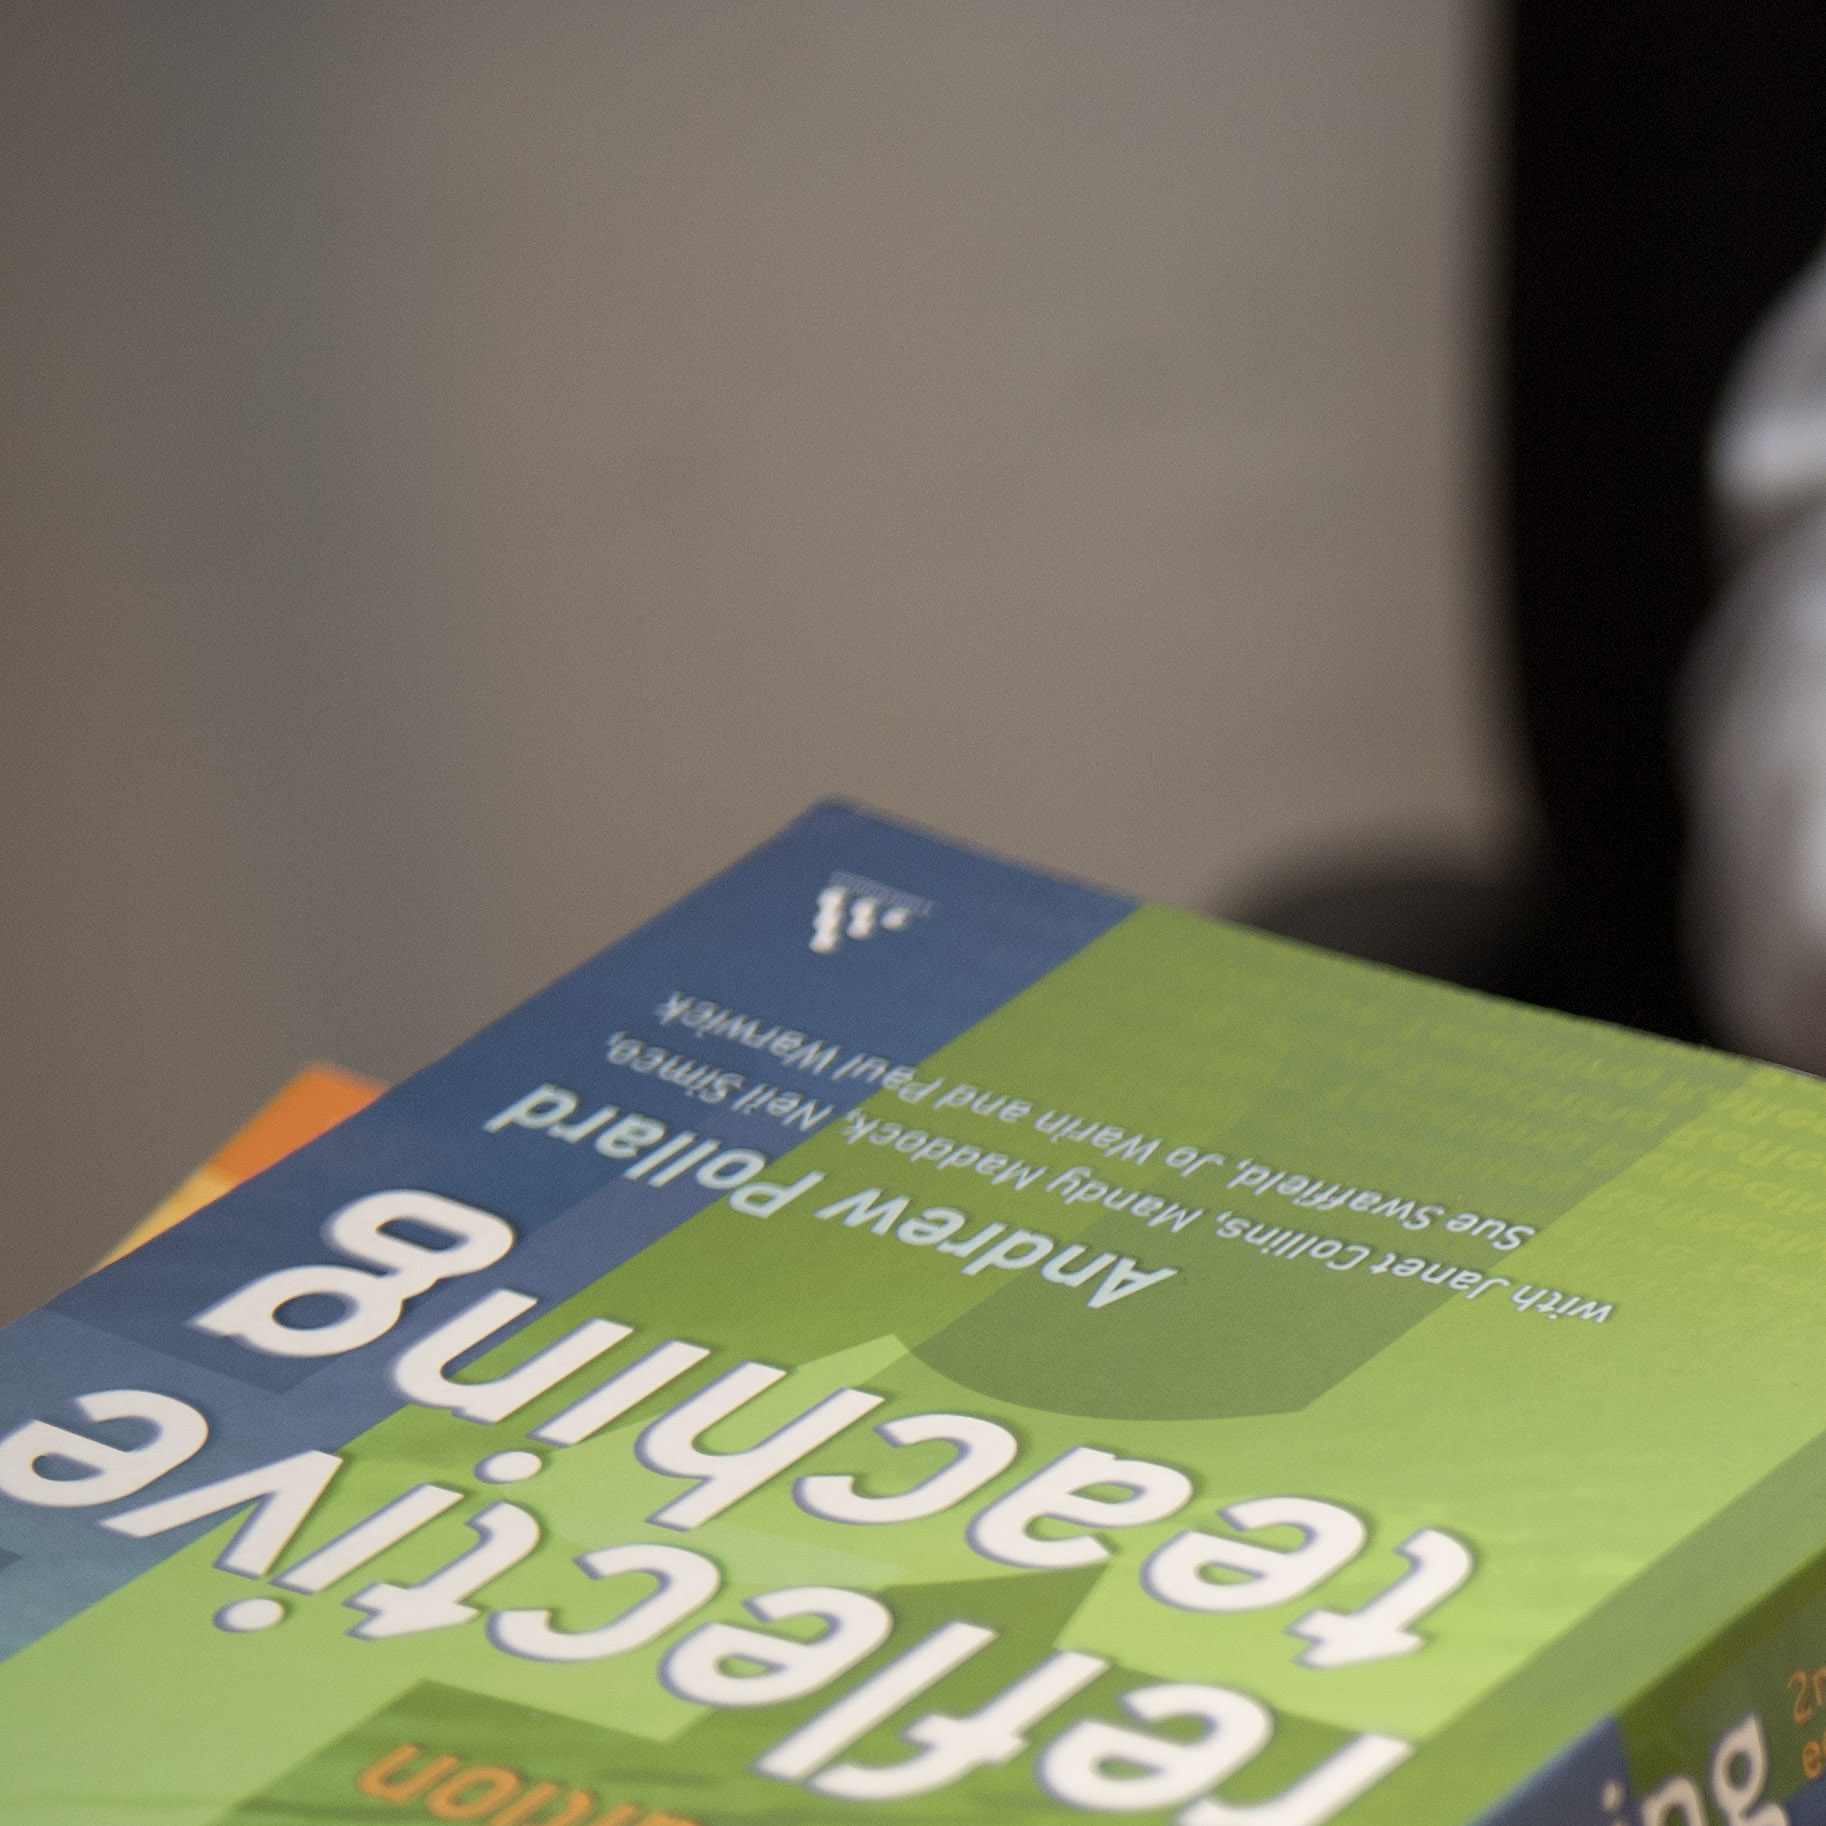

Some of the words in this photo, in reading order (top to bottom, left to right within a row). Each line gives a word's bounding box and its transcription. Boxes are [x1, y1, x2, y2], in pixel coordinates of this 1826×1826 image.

[653, 990, 844, 1076] Warwick
[734, 1076, 835, 1132] Neil
[832, 1042, 945, 1105] Paul
[935, 1074, 1032, 1124] and
[483, 1083, 825, 1218] Pollard
[842, 1107, 1048, 1191] Maddock,
[1034, 1108, 1164, 1166] Warin
[1165, 1144, 1224, 1178] Jo
[1046, 1166, 1203, 1234] Mandy
[1226, 1157, 1446, 1232] Swaffield,
[814, 1186, 1178, 1309] Andrew
[1214, 1210, 1370, 1272] Collins,
[1446, 1211, 1536, 1253] Sue
[1370, 1253, 1511, 1300] Janet
[1510, 1281, 1616, 1325] with
[187, 1189, 1478, 1669] teaching
